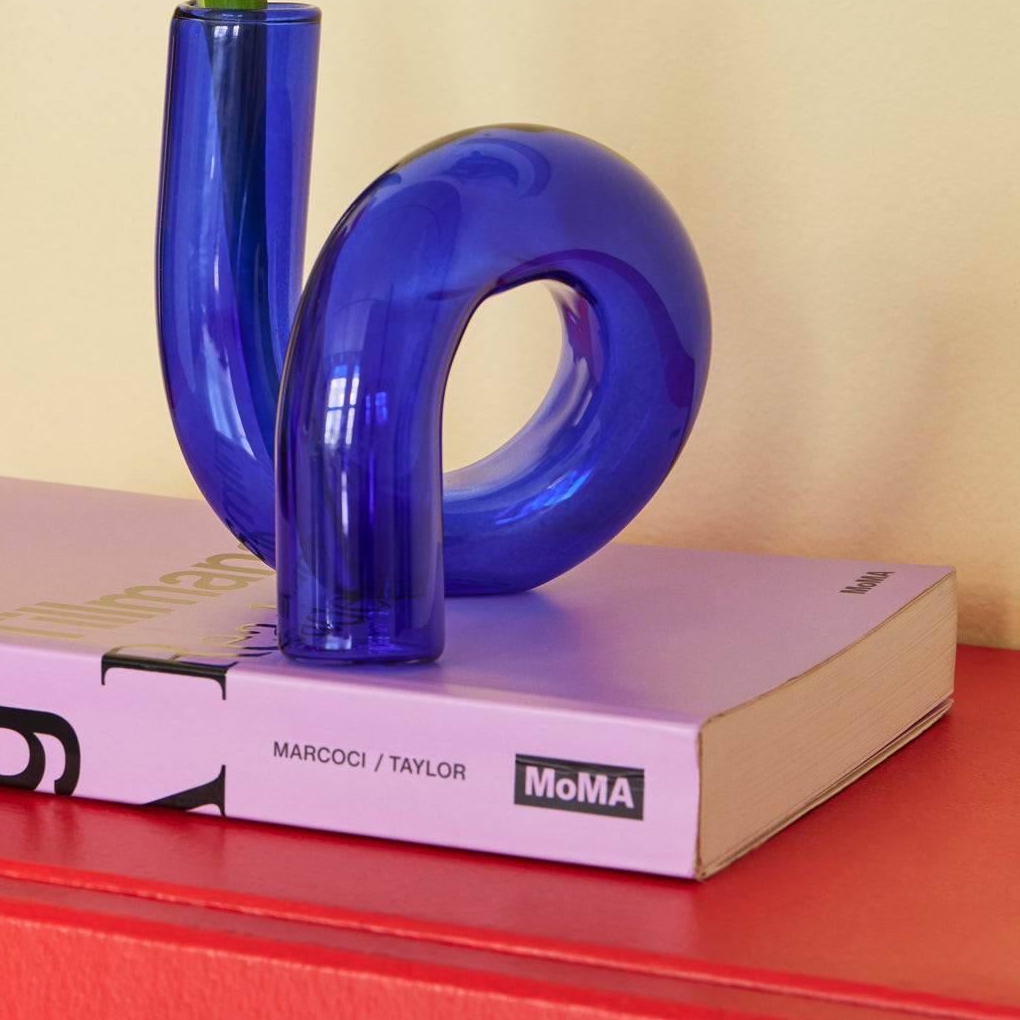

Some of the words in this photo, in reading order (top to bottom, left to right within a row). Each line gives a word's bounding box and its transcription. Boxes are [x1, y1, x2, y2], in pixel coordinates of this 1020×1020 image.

[839, 571, 895, 595] MoMA
[273, 741, 367, 768] MARCOCI
[373, 753, 385, 773] /
[389, 755, 467, 781] TAYLOR
[524, 765, 636, 809] MoMA
